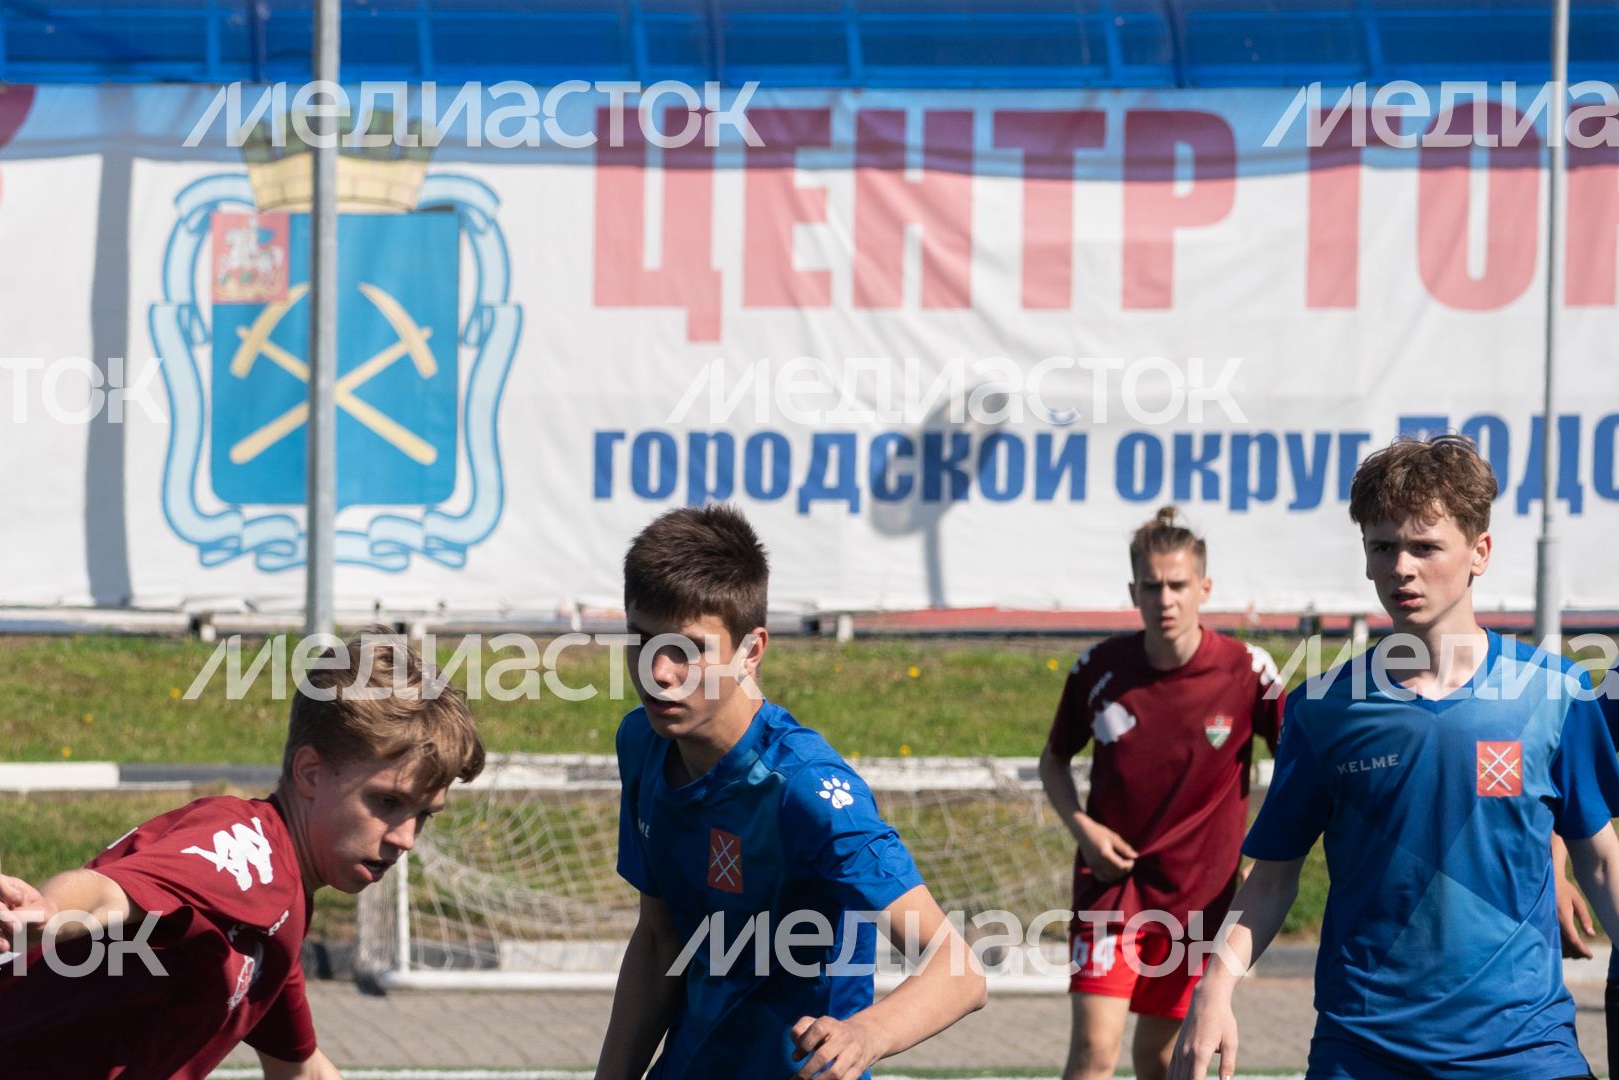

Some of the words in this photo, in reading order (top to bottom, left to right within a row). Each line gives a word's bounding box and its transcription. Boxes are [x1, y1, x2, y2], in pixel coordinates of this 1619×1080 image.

[593, 106, 1237, 344] ЦЕНТР
[592, 407, 1089, 516] городской
[1114, 431, 1371, 512] округ
[1337, 754, 1400, 775] KELME
